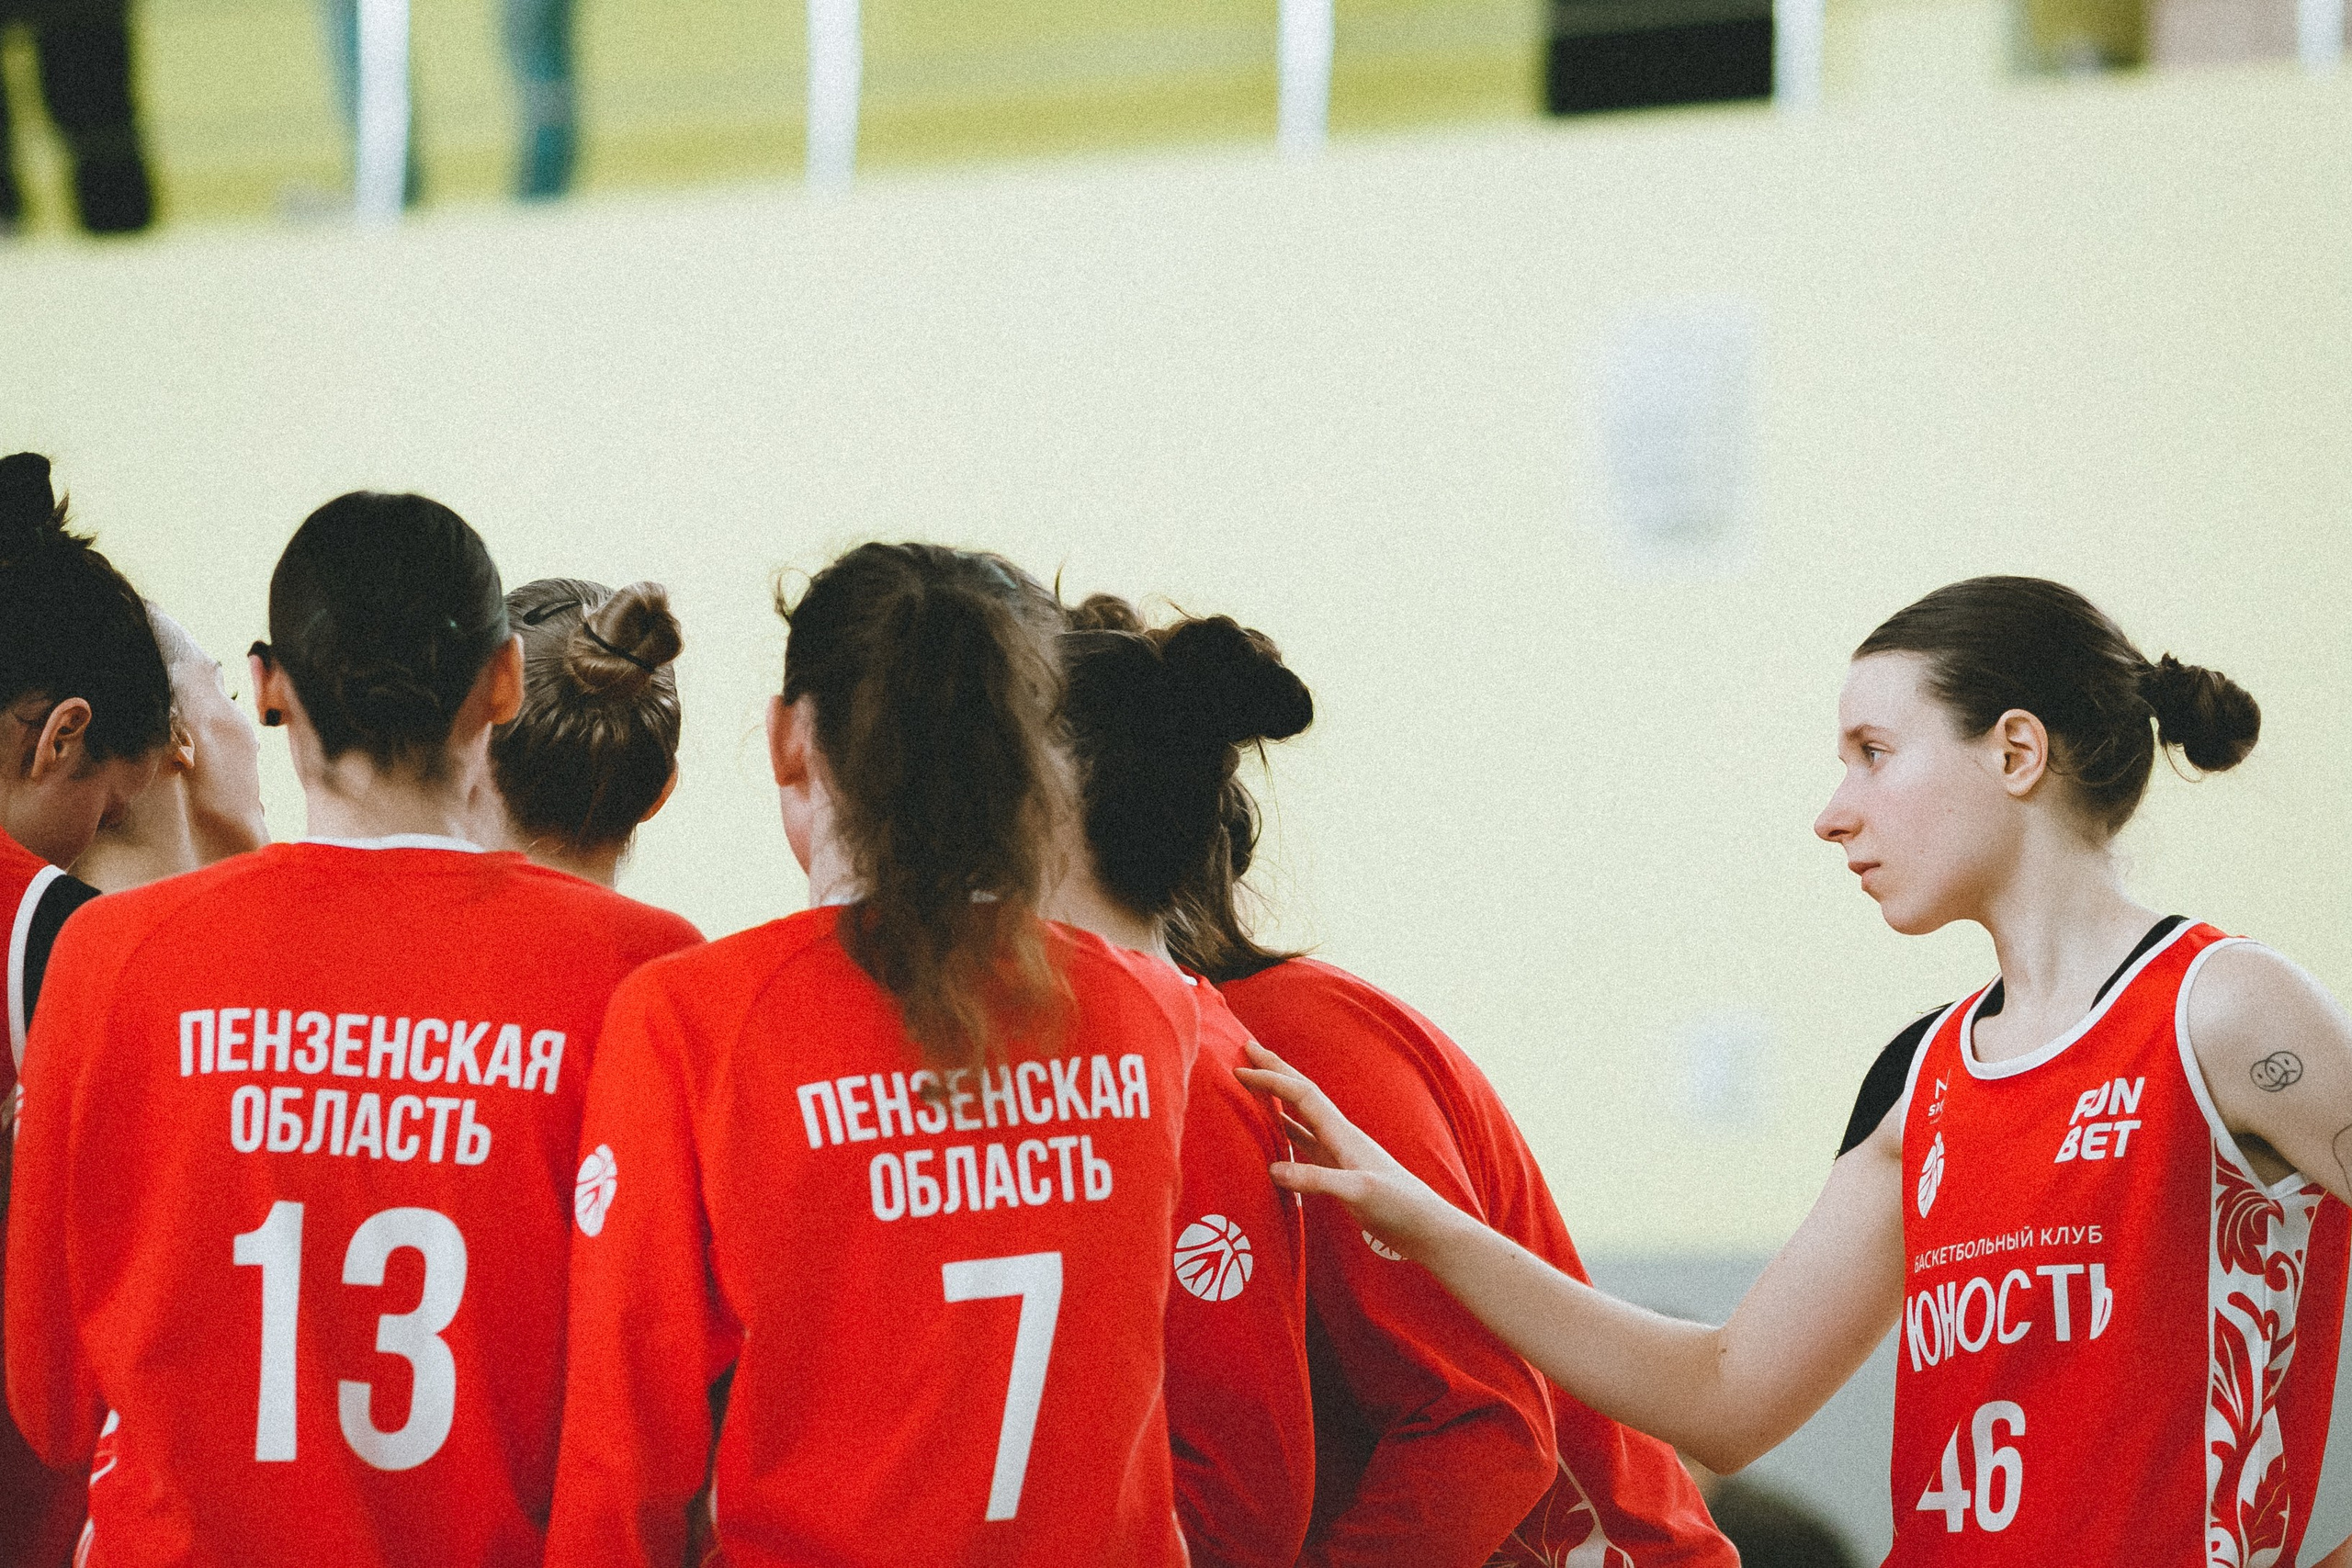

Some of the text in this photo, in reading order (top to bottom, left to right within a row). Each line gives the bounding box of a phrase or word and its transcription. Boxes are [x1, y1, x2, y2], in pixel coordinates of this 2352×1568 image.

[179, 1007, 567, 1095] ПЕНЗЕНСКАЯ
[231, 1084, 492, 1167] ОБЛАСТЬ
[796, 1054, 1150, 1150] ПЕНЗЕНСКАЯ
[2053, 1119, 2143, 1164] BET
[2068, 1076, 2145, 1126] FON
[868, 1134, 1114, 1222] ОБЛАСТЬ
[1914, 1224, 2104, 1274] БАСКЕТБОЛЬНЫЙ КЛУБ
[232, 1200, 469, 1471] 13
[1906, 1262, 2113, 1372] ЮНОСТЬ
[941, 1251, 1065, 1522] 7
[1916, 1400, 2027, 1533] 46
